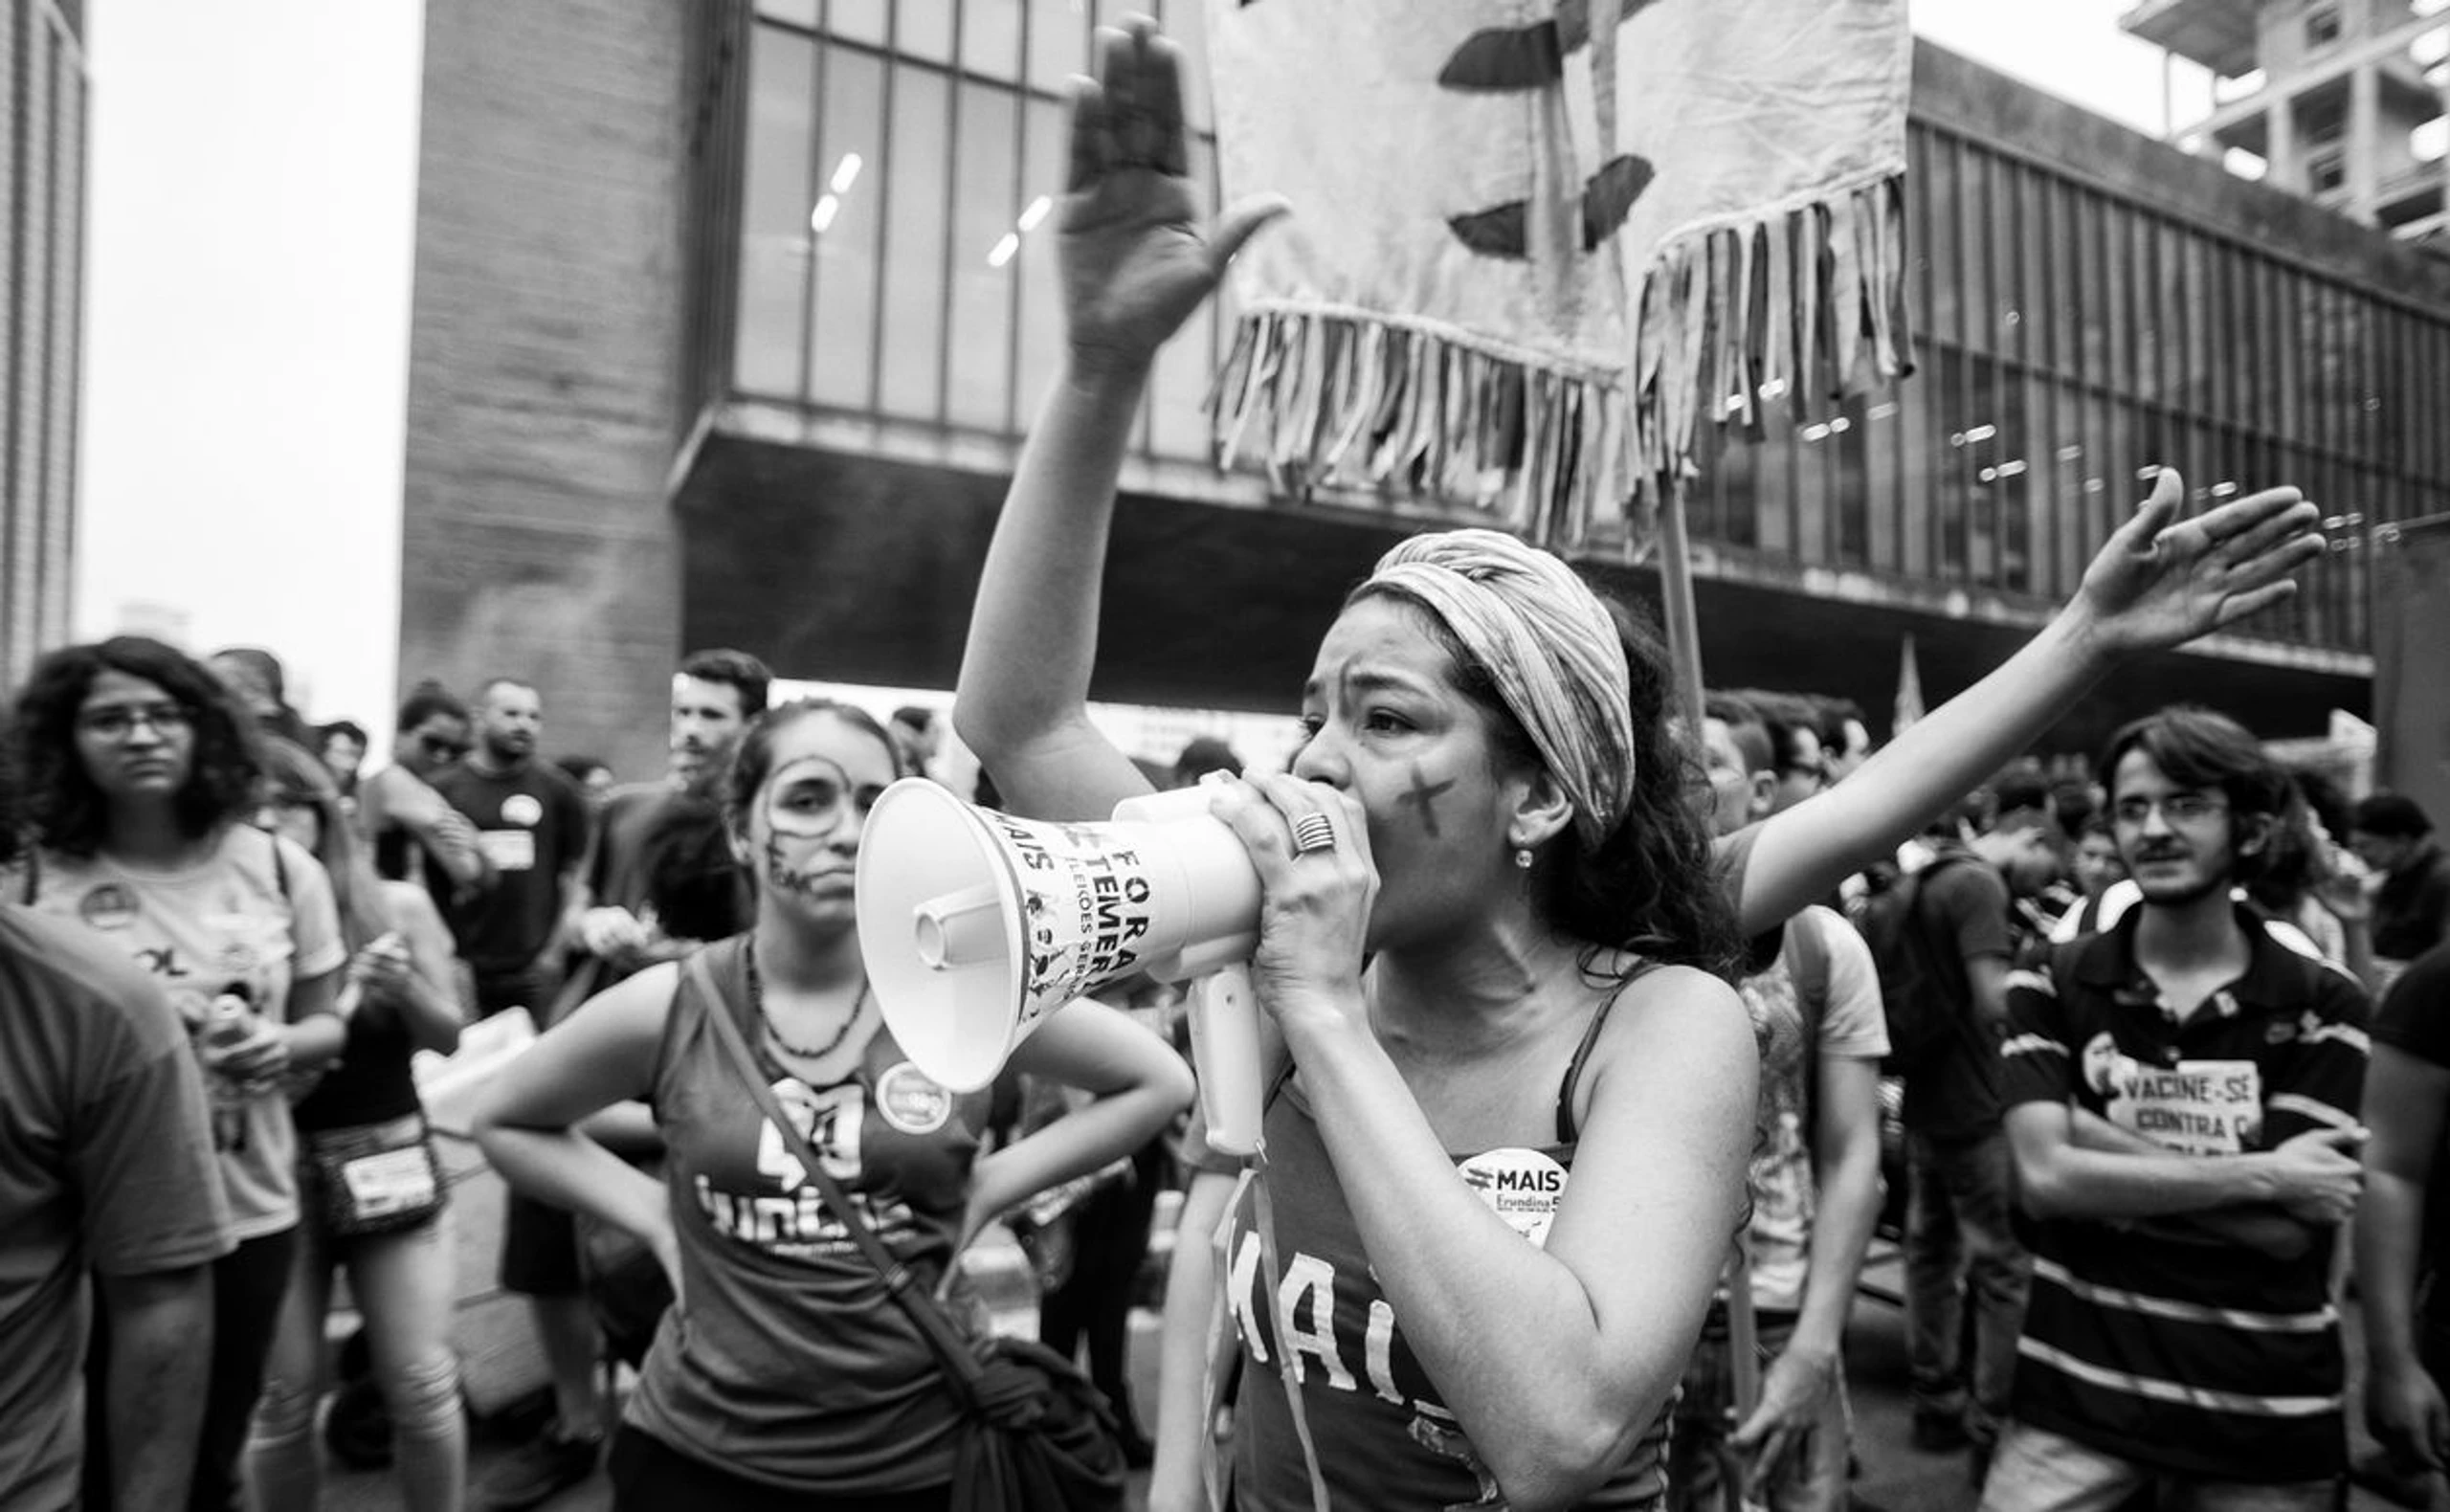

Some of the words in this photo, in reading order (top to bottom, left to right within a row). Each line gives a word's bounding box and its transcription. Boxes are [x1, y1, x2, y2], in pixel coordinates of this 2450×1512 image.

[1084, 855, 1121, 976] TEMER
[1108, 850, 1149, 971] FORA
[2135, 1107, 2227, 1138] CONTRA
[1496, 1168, 1562, 1192] MAIS
